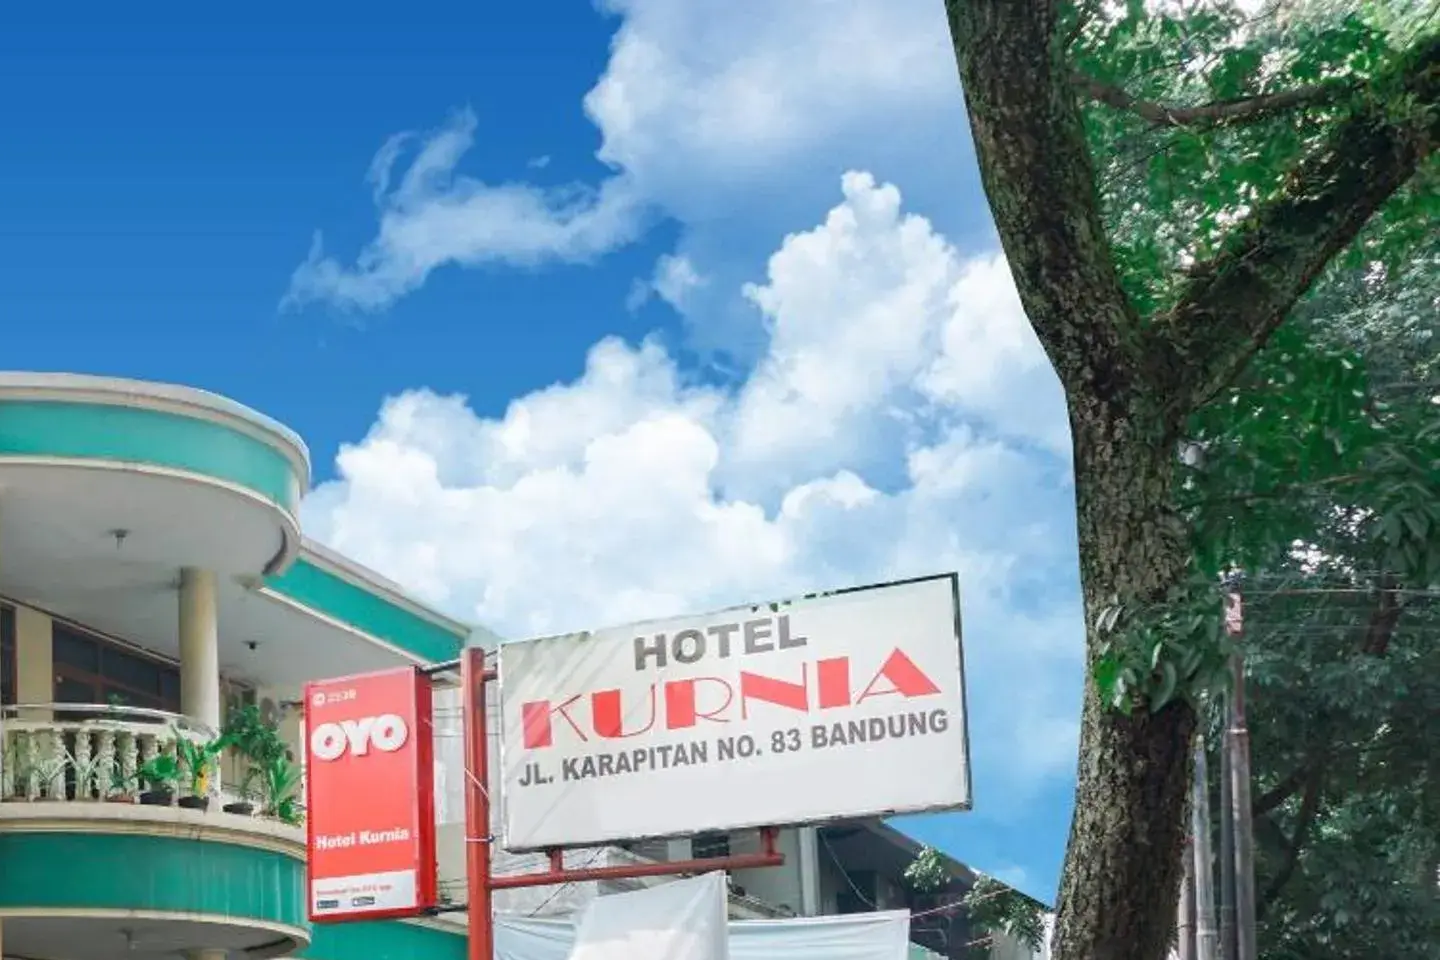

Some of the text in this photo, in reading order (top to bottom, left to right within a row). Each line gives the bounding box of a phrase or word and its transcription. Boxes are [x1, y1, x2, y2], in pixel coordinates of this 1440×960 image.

[634, 615, 808, 671] HOTEL
[521, 647, 942, 750] KURNIA
[311, 713, 409, 761] OYO
[518, 709, 949, 788] JL. KARAPITAN NO. 83 BANDUNG
[316, 828, 410, 850] Hotel Kurnia
